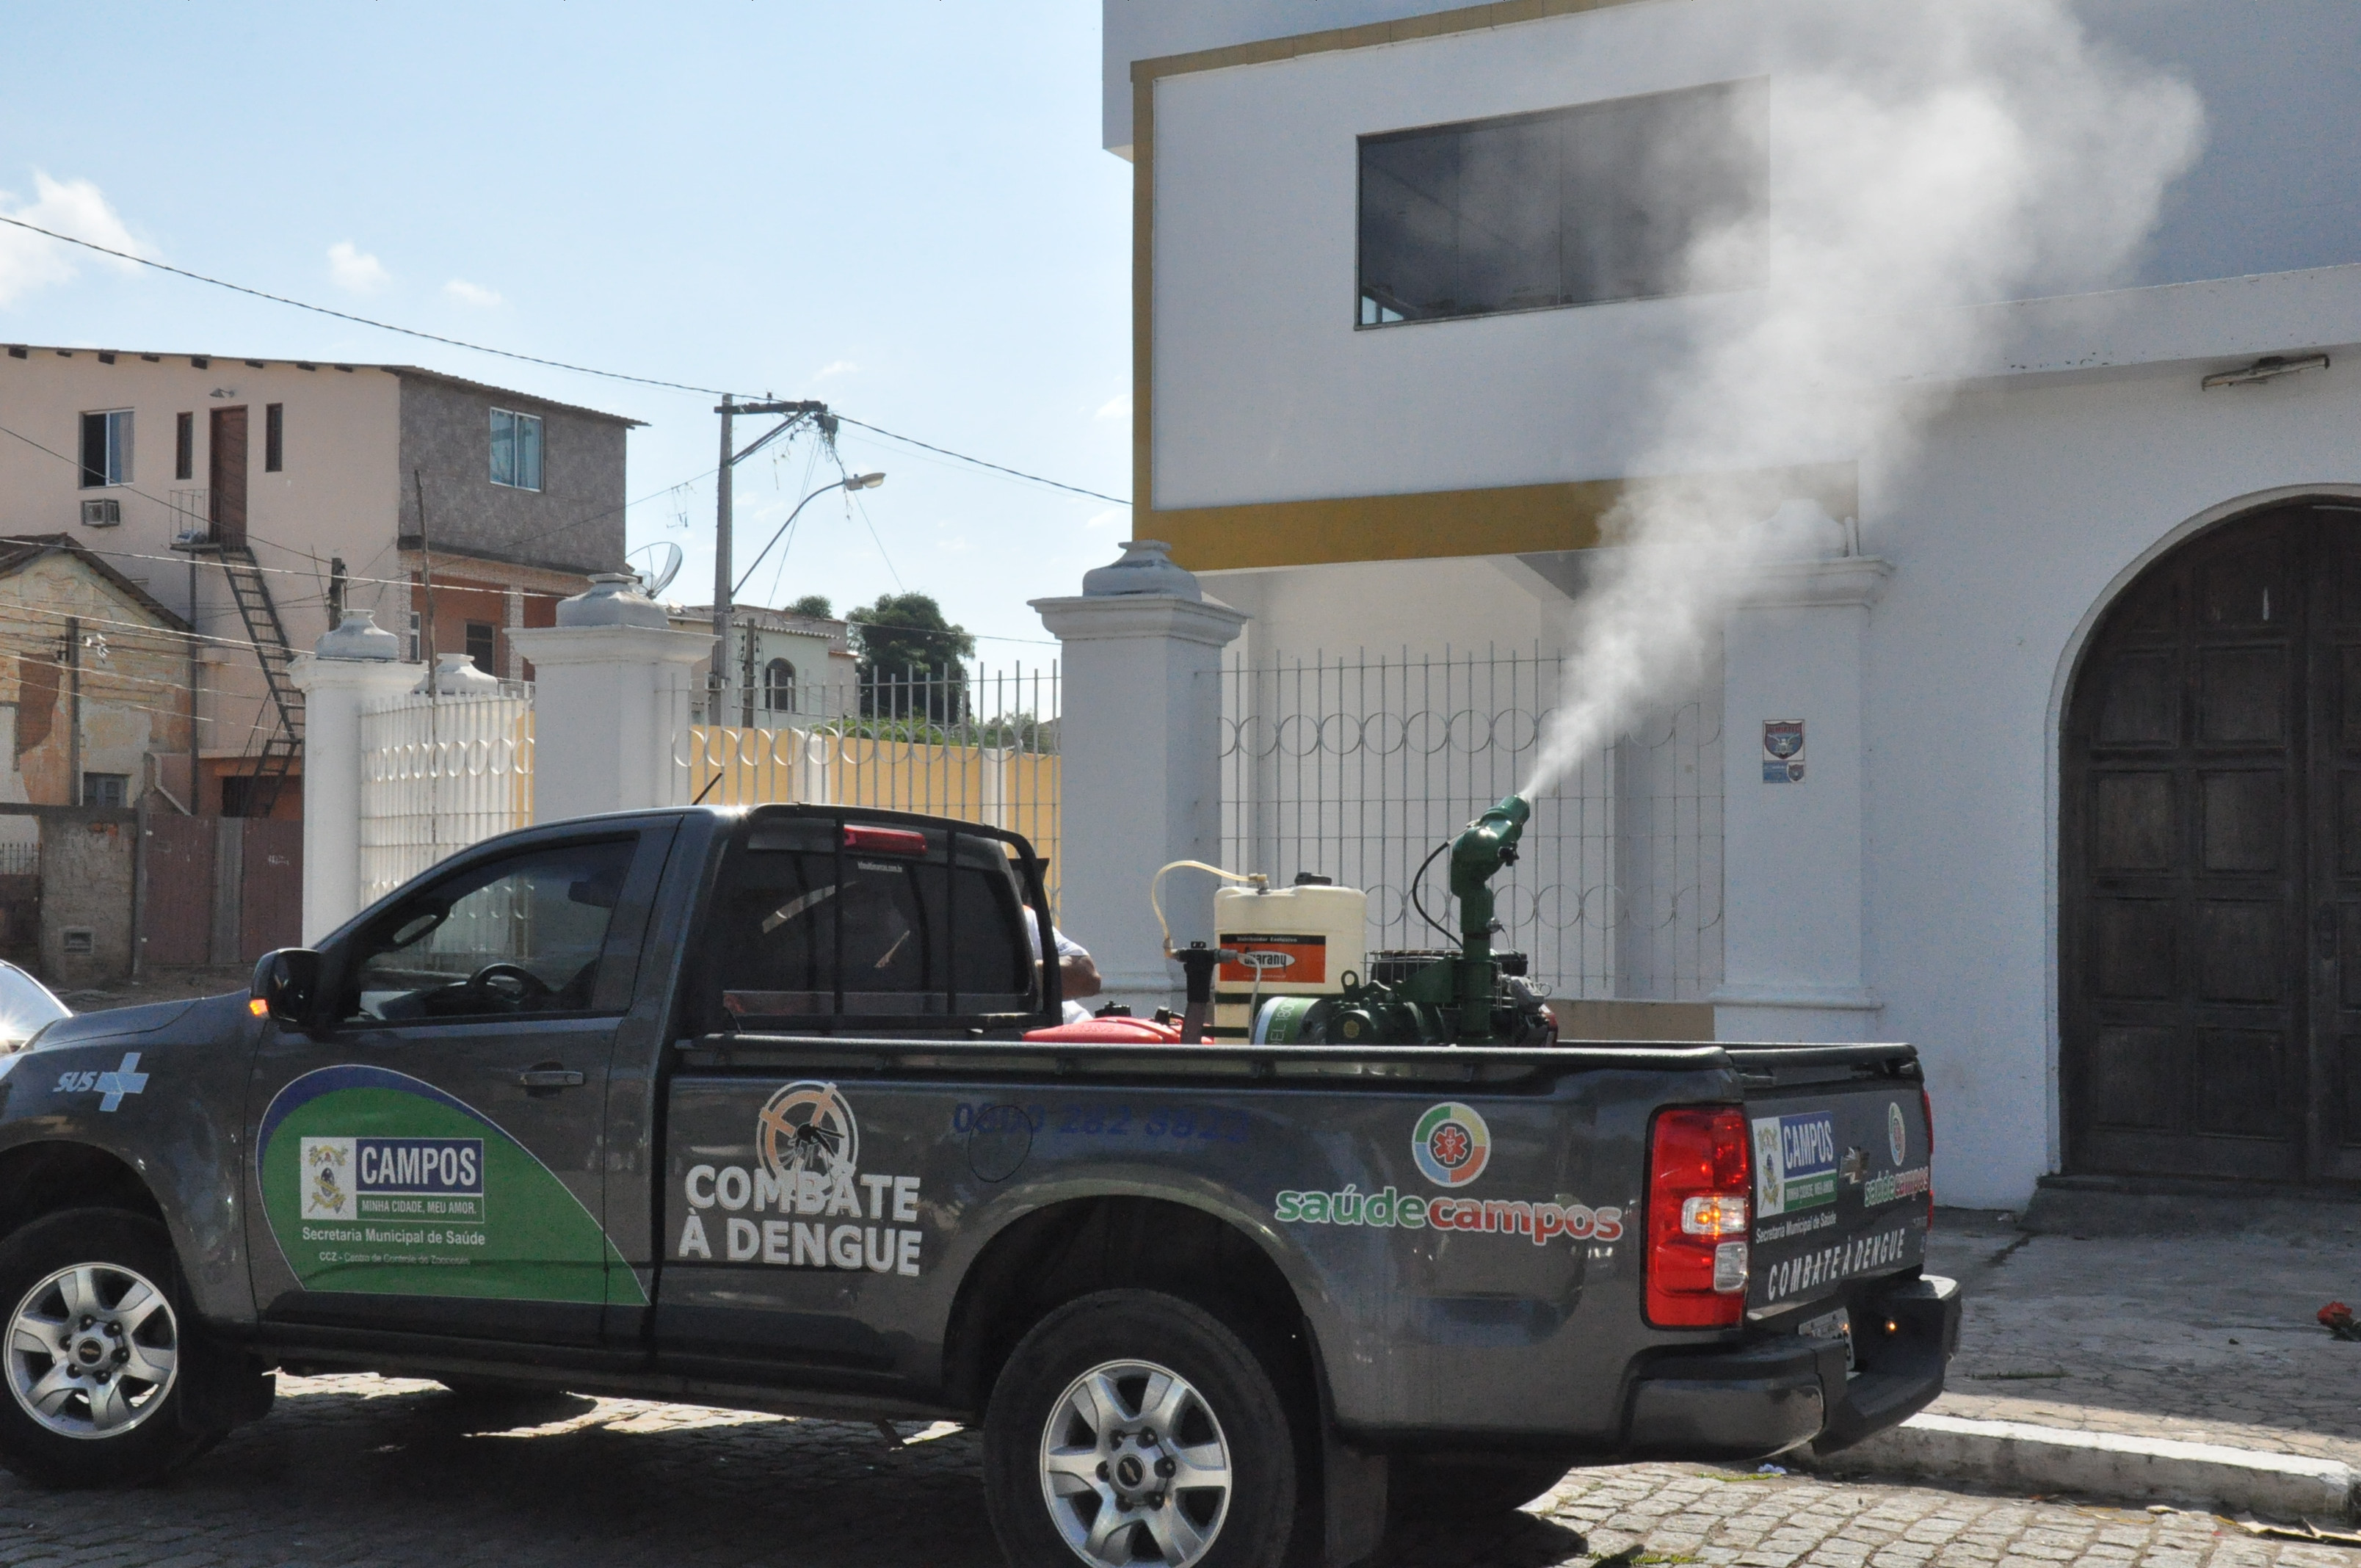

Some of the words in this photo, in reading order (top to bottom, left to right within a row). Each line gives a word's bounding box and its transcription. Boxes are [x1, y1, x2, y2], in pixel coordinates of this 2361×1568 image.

[52, 1071, 98, 1092] SUS
[1783, 1119, 1834, 1170] CAMPOS
[361, 1146, 476, 1186] CAMPOS
[362, 1199, 389, 1212] MINHA
[392, 1201, 425, 1214] CIDADE,
[427, 1202, 446, 1213] MEU
[449, 1202, 477, 1215] AMOR.
[684, 1164, 921, 1222] COMBATE
[302, 1227, 362, 1241] Secretaria
[366, 1228, 424, 1246] Municipal
[427, 1230, 442, 1244] de
[446, 1230, 485, 1245] Saúde
[678, 1208, 712, 1259] À
[726, 1217, 923, 1277] DENGUE
[1756, 1222, 1785, 1244] Secretaria
[1785, 1215, 1813, 1236] Municipal
[1813, 1215, 1821, 1230] de
[319, 1252, 337, 1262] CCZ
[1768, 1246, 1841, 1301] COMBATE
[1842, 1235, 1852, 1276] À
[1854, 1228, 1905, 1272] DENGUE
